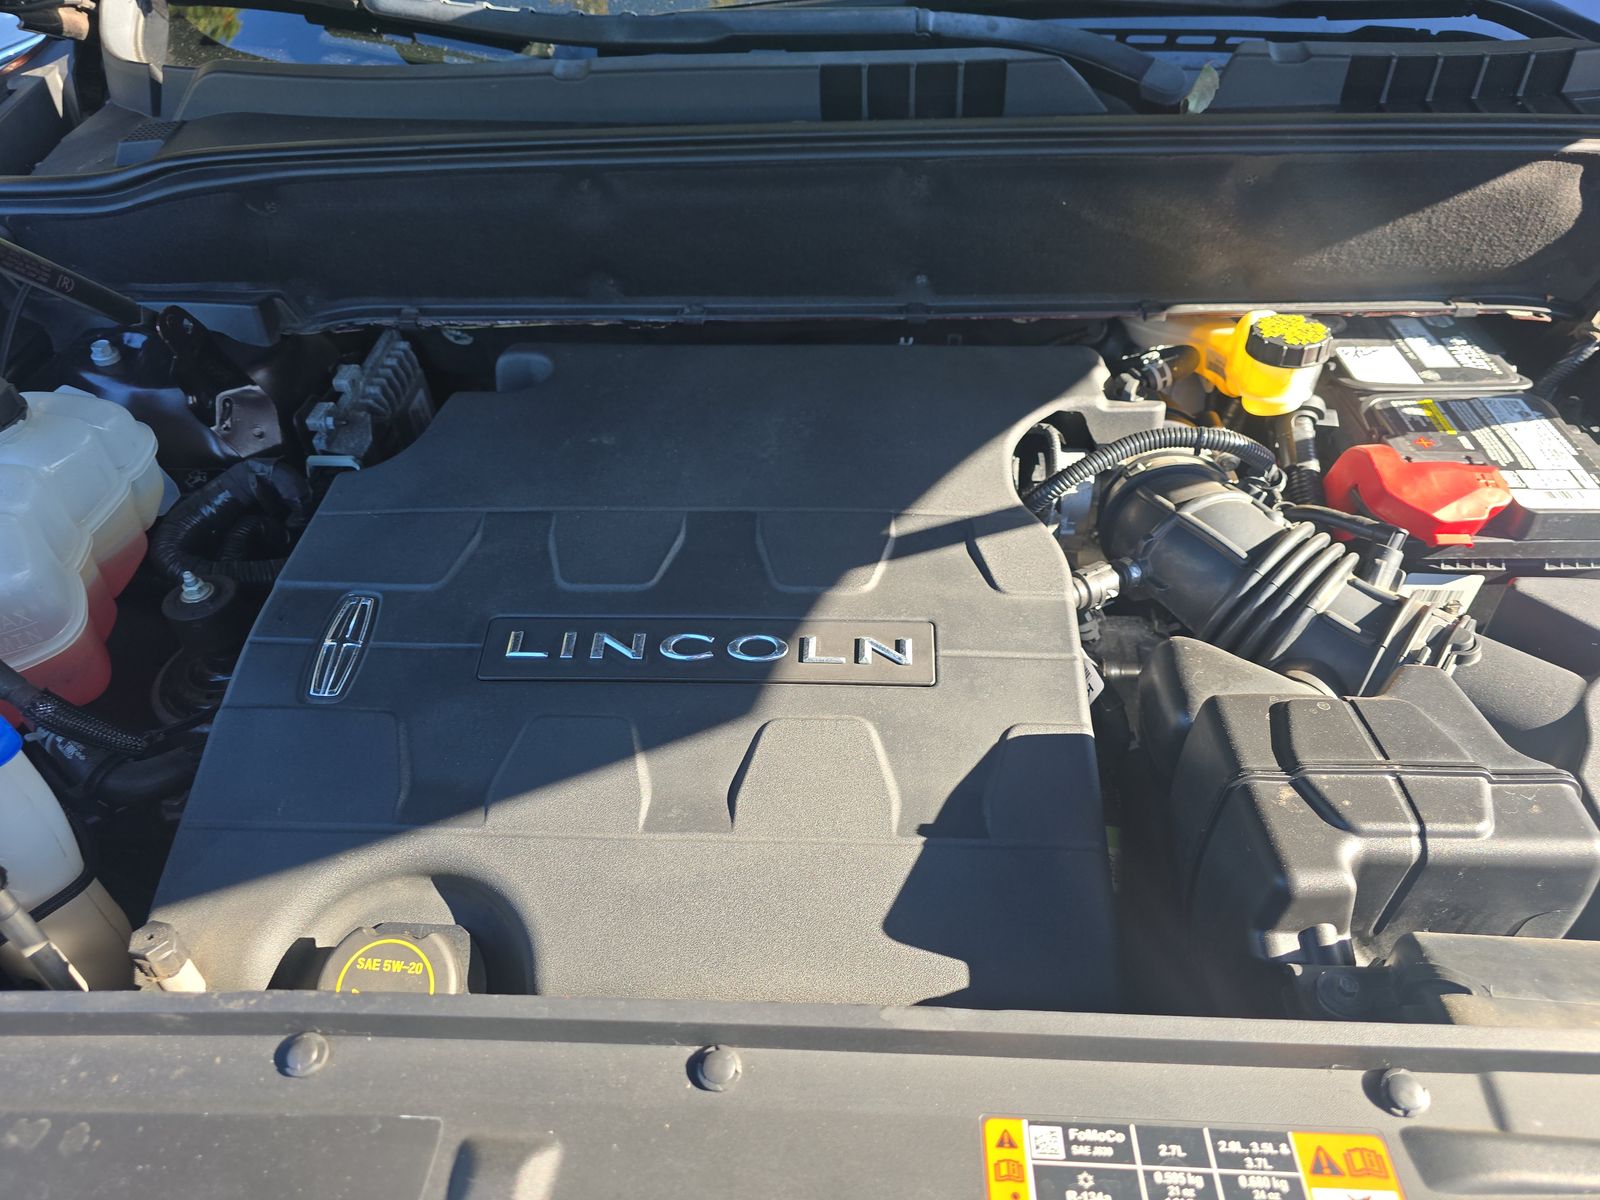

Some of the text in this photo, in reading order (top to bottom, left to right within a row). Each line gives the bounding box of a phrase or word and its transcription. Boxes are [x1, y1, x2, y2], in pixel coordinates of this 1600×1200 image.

[505, 631, 913, 666] LINCOLN
[356, 957, 424, 975] SAE 5W-20
[1068, 1128, 1126, 1143] FoMoCo
[1158, 1144, 1187, 1157] 2.7L
[1250, 1141, 1278, 1155] 3.5L
[1279, 1143, 1291, 1155] &
[1244, 1157, 1274, 1169] 3.7L
[1187, 1172, 1204, 1189] kg
[1271, 1176, 1290, 1193] kg
